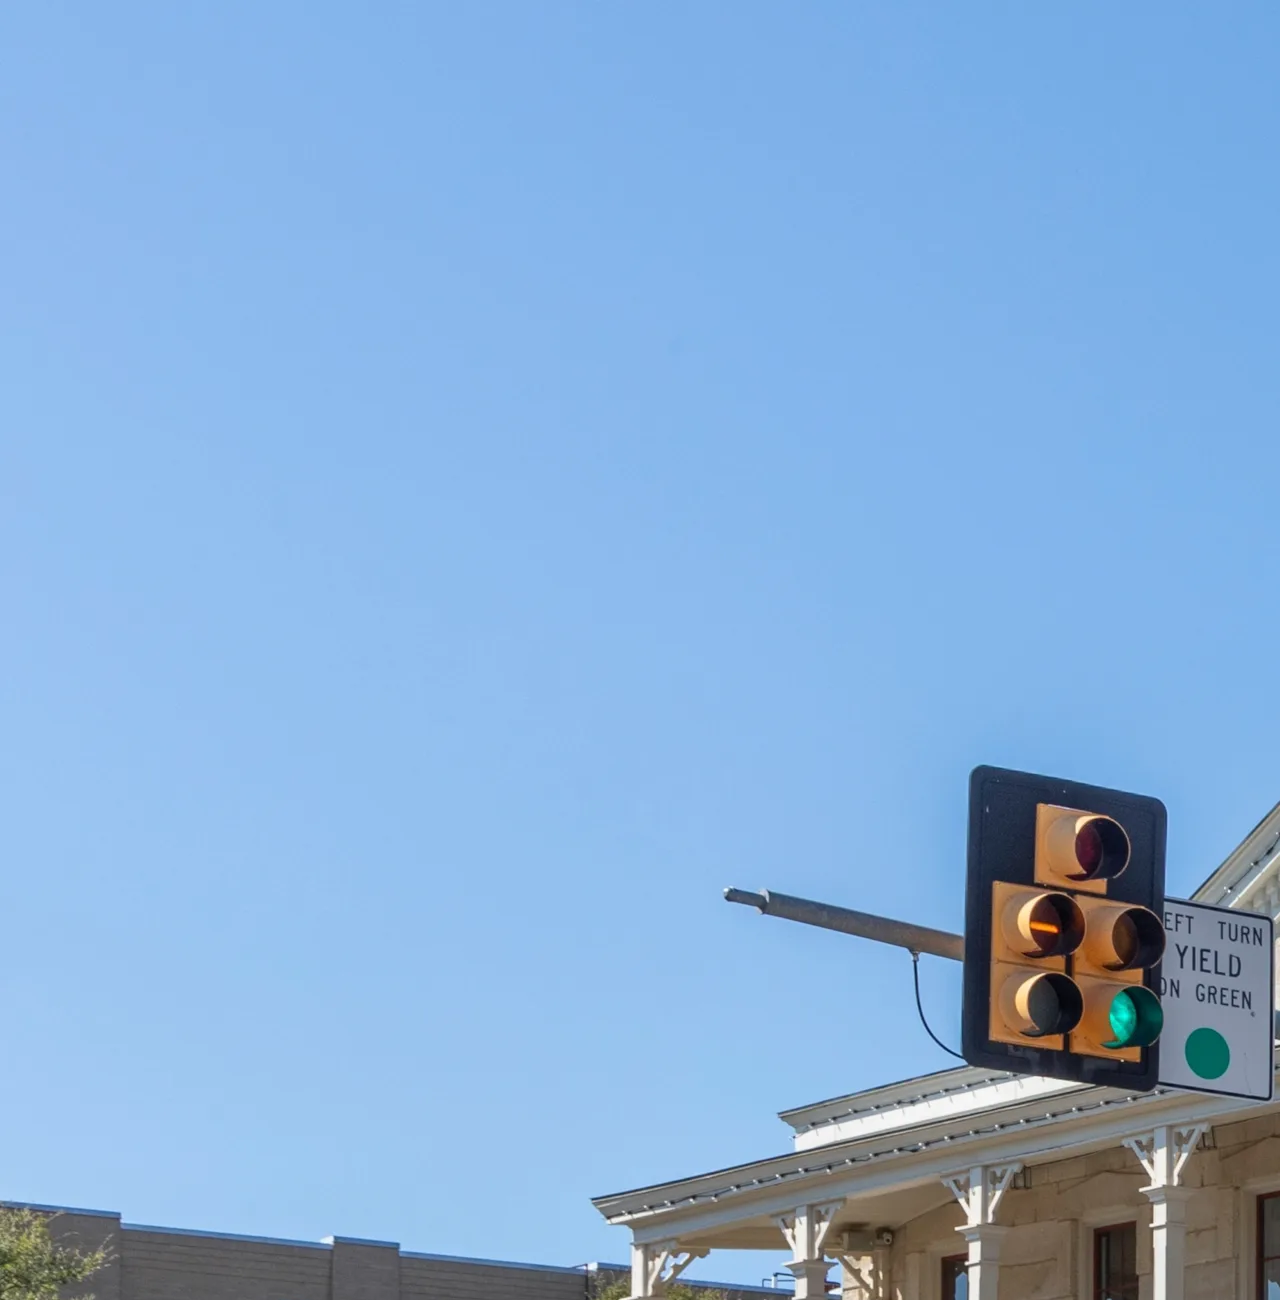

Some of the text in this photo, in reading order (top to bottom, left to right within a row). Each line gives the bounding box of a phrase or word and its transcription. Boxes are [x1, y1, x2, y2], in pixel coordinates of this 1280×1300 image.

[1164, 911, 1263, 947] EFT TURN
[1174, 943, 1242, 978] YIELD
[1195, 983, 1252, 1010] GREEN
